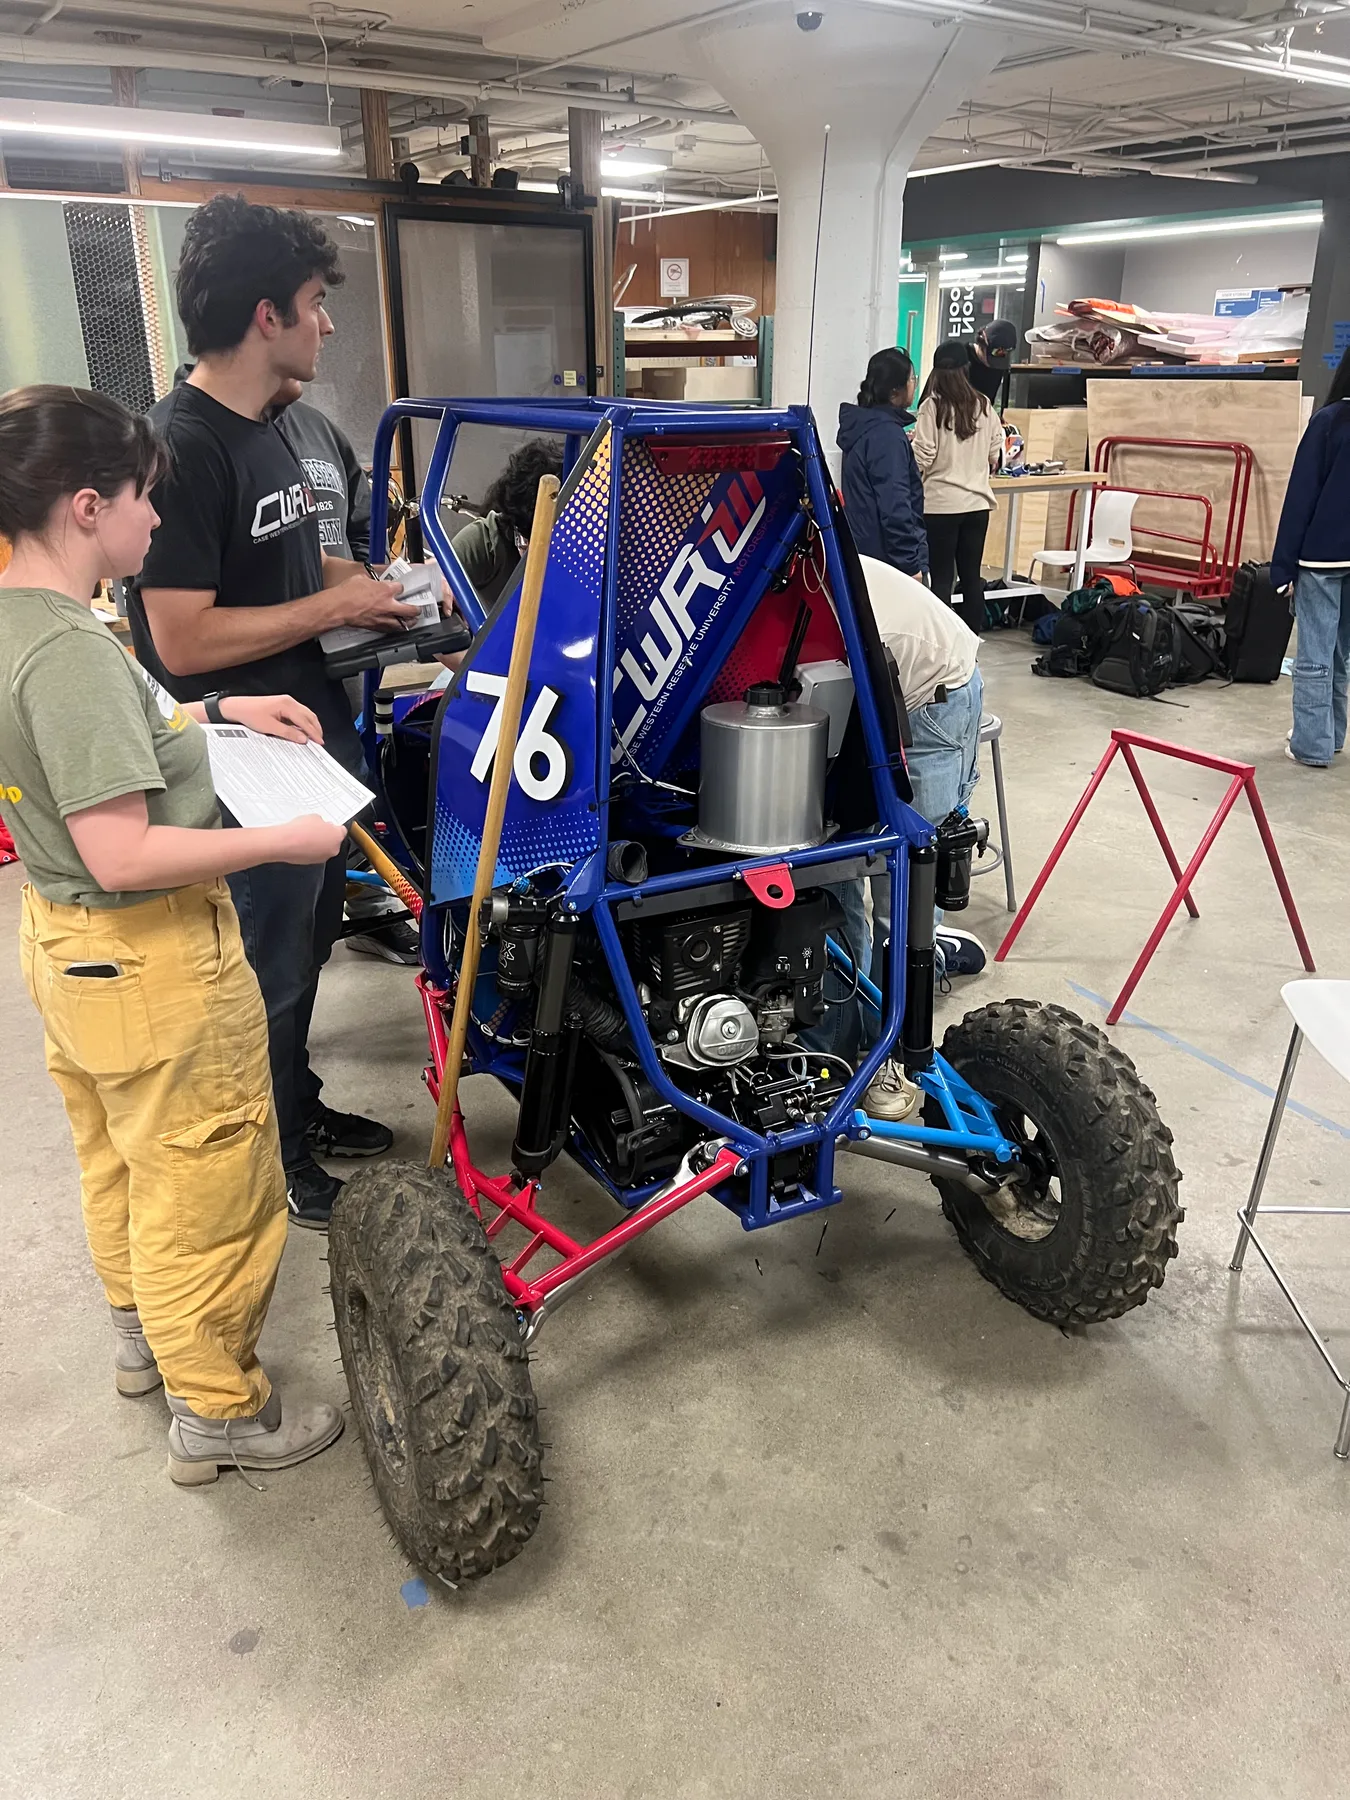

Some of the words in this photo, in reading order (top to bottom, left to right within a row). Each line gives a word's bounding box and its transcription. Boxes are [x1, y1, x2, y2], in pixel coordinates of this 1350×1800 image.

[253, 534, 269, 545] CASE
[621, 742, 642, 767] CSE
[637, 691, 670, 740] WESTERN
[666, 642, 699, 691] RESERVE
[694, 577, 736, 641] UNIVERSITY
[733, 491, 788, 577] MOTORSPORTS
[466, 670, 566, 801] 76
